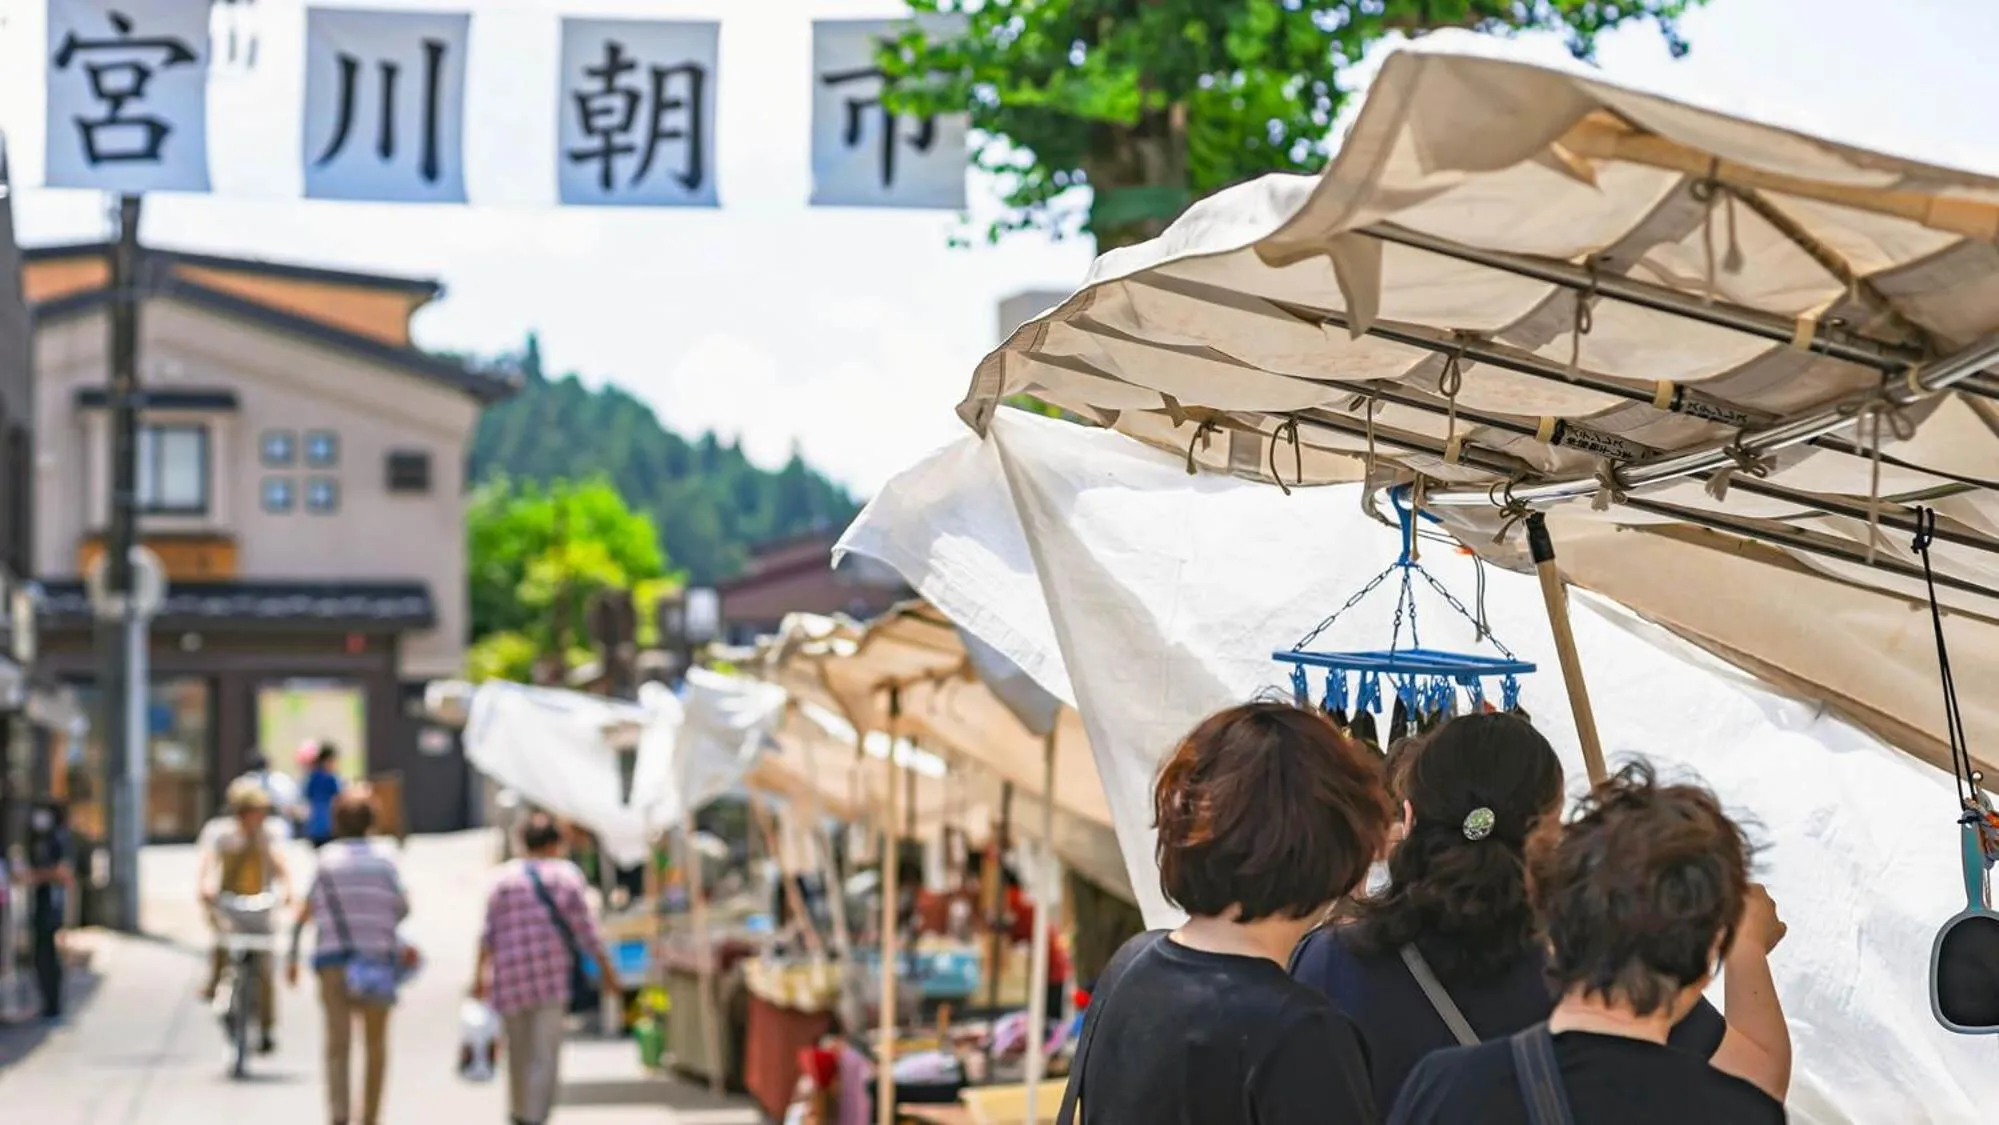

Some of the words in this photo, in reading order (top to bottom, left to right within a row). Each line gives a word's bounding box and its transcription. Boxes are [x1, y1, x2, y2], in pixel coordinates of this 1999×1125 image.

[54, 9, 199, 168] 宮
[313, 37, 448, 184] 川
[566, 41, 708, 194] 朝
[1570, 426, 1625, 449] ステンレス
